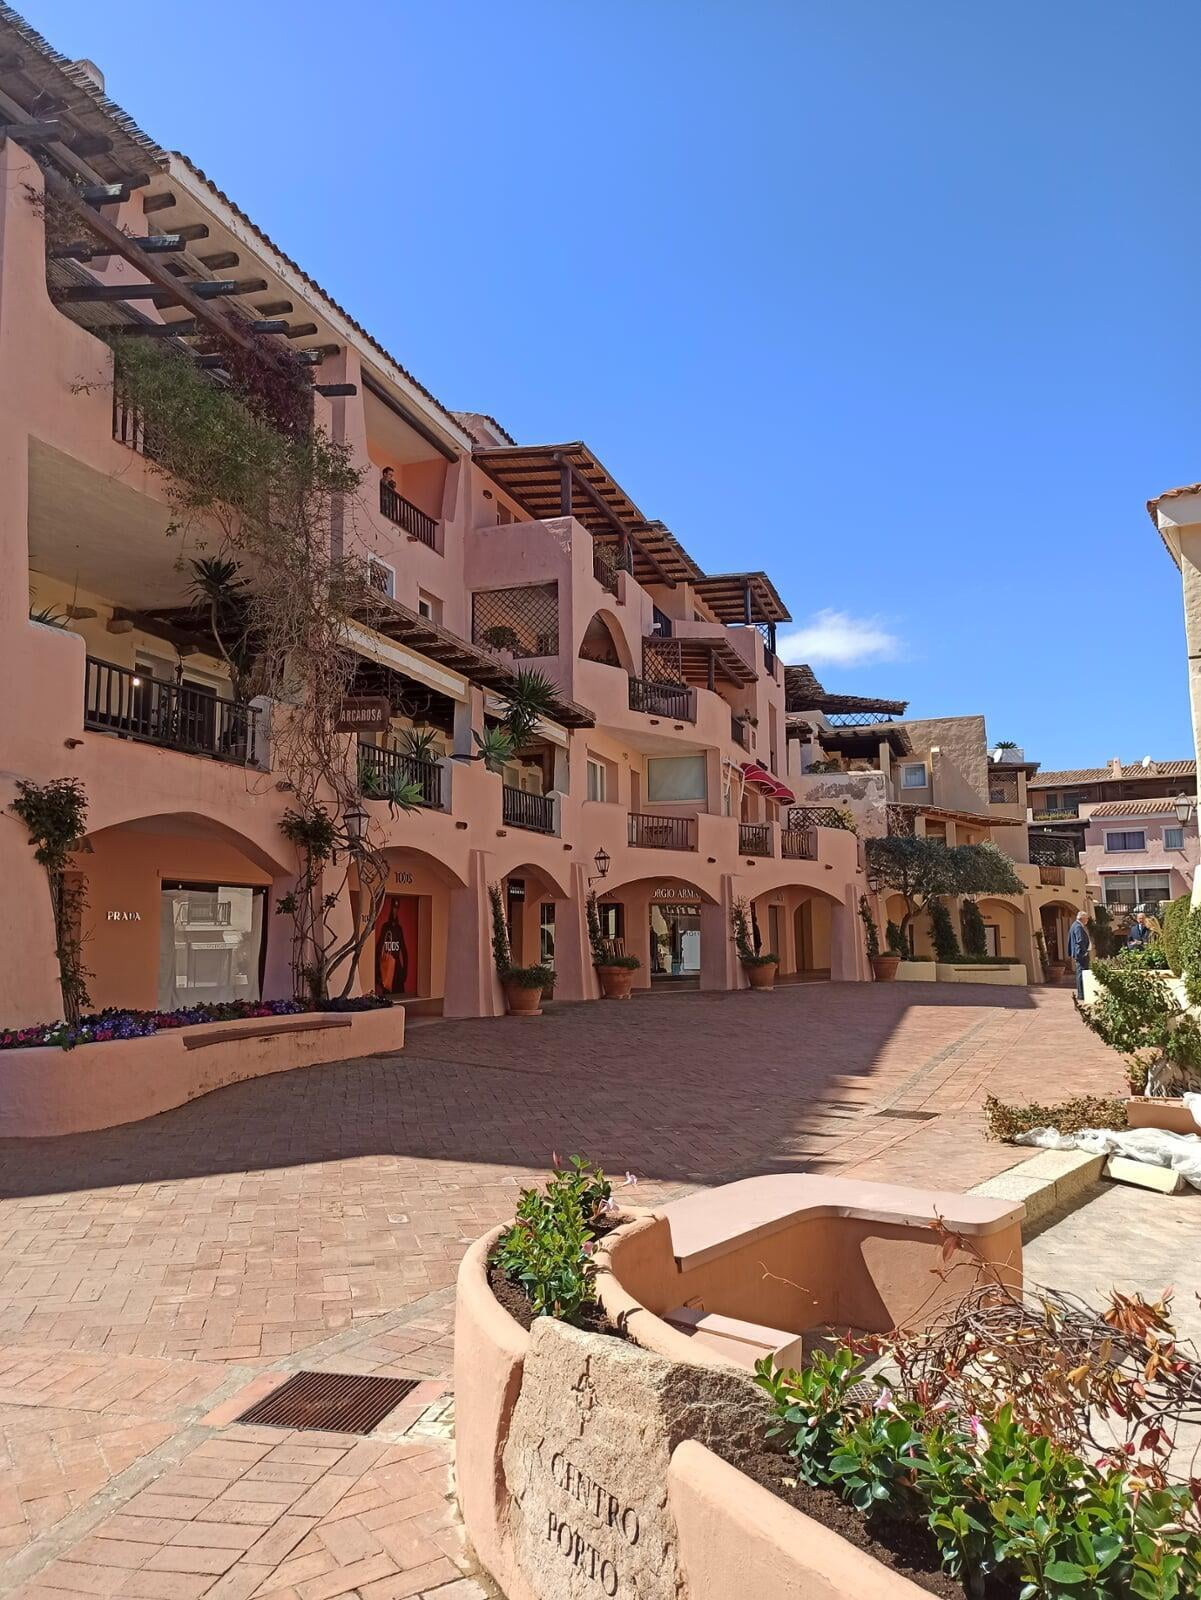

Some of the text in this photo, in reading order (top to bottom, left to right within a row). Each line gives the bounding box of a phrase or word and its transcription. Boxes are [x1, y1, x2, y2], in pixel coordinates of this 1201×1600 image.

[107, 911, 141, 921] PRADA
[551, 1452, 640, 1546] CENTRO
[546, 1508, 619, 1598] PORTO
